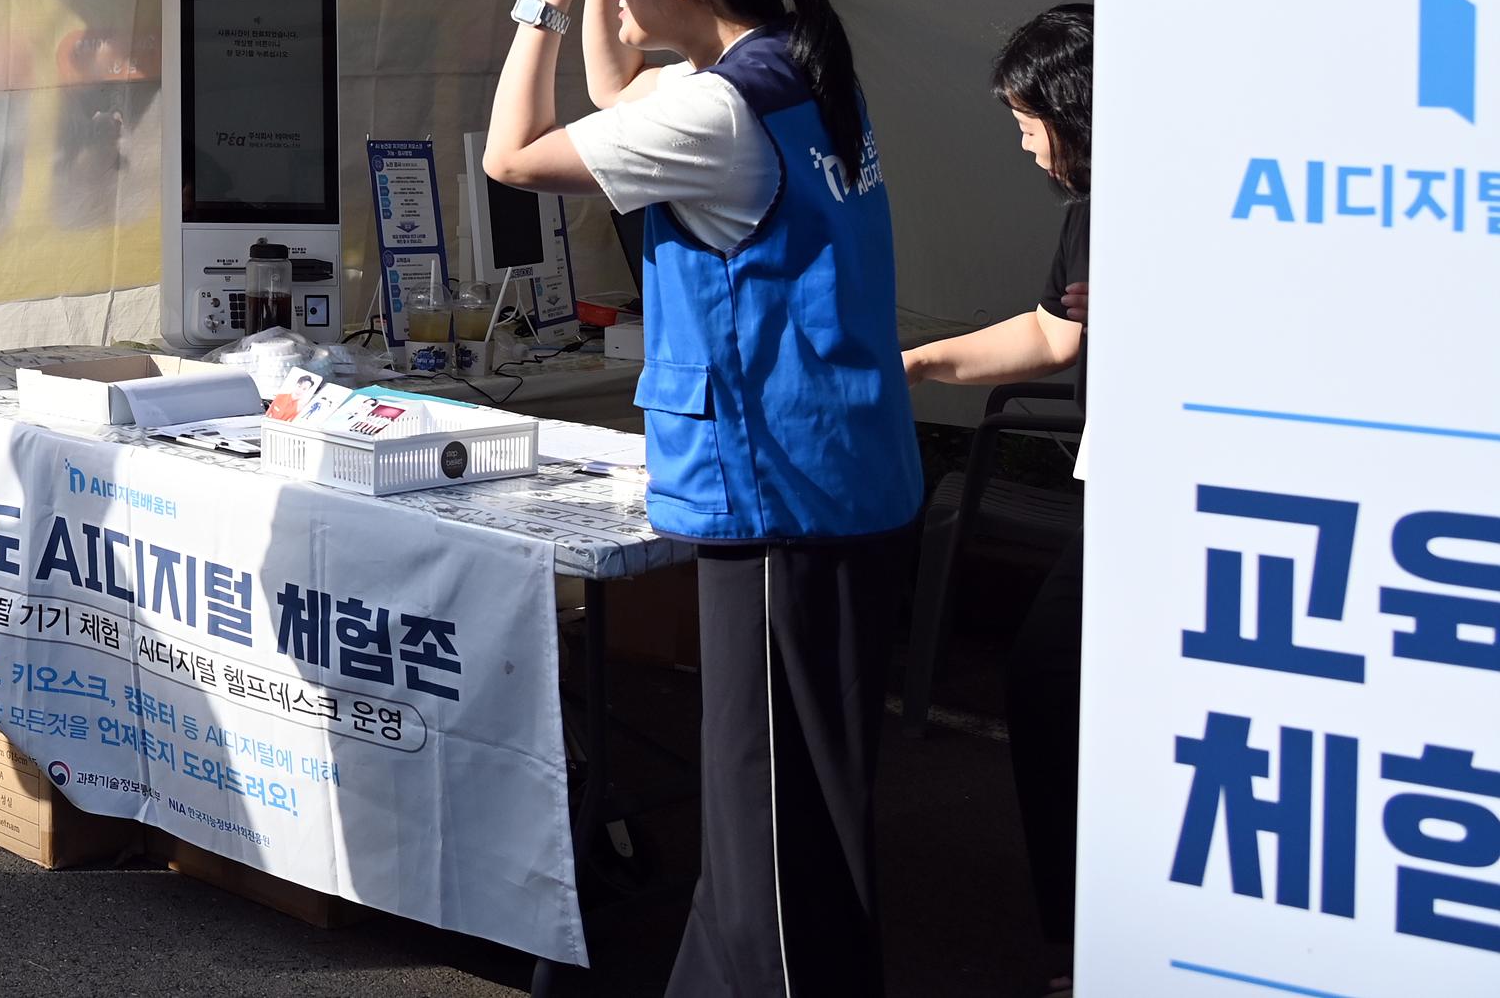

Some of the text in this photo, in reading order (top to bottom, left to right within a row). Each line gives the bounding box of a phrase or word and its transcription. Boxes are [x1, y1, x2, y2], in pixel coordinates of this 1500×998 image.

[90, 476, 177, 519] AI디지털배움터
[35, 515, 252, 648] AI디지털
[277, 582, 461, 702] 체험존
[12, 663, 116, 707] 키오스크,
[124, 686, 177, 733] 컴퓨터
[182, 715, 198, 741] 등
[206, 725, 293, 774] AI디지털에
[302, 756, 340, 787] 대해
[19, 606, 70, 636] 기기
[79, 612, 120, 650] 체험
[138, 635, 216, 687] AI디지털
[223, 664, 342, 722] 헬프데스크
[351, 701, 401, 741] 운영
[10, 707, 89, 740] 모든것을
[98, 716, 176, 771] 언제든지
[182, 751, 298, 817] 도와드려요!
[169, 798, 186, 816] NIA
